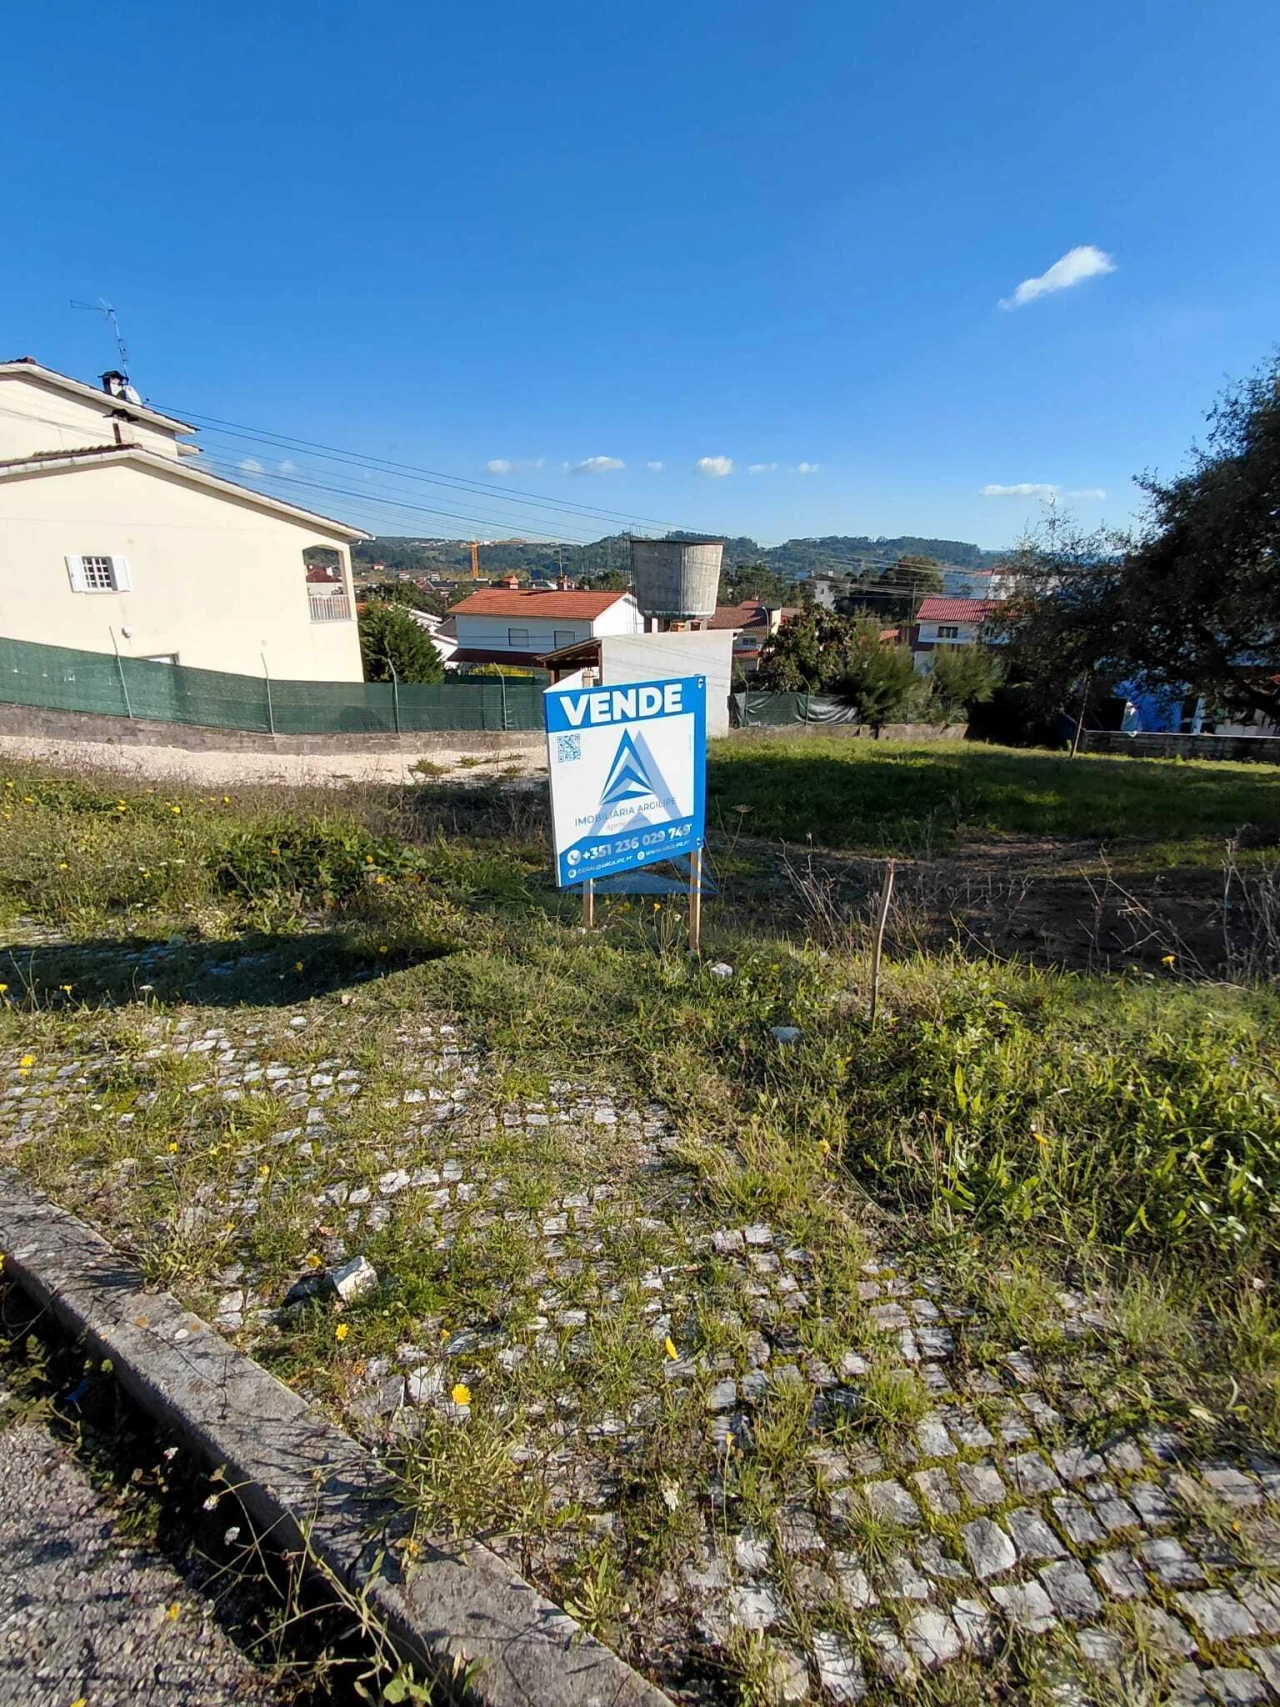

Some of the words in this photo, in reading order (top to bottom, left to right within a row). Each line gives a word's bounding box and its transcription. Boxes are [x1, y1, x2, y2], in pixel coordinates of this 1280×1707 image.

[560, 684, 683, 726] VENDE
[637, 797, 677, 812] ARGILIPE
[582, 843, 612, 860] +351
[615, 837, 639, 853] 236
[642, 830, 666, 846] 029
[668, 823, 693, 839] 749
